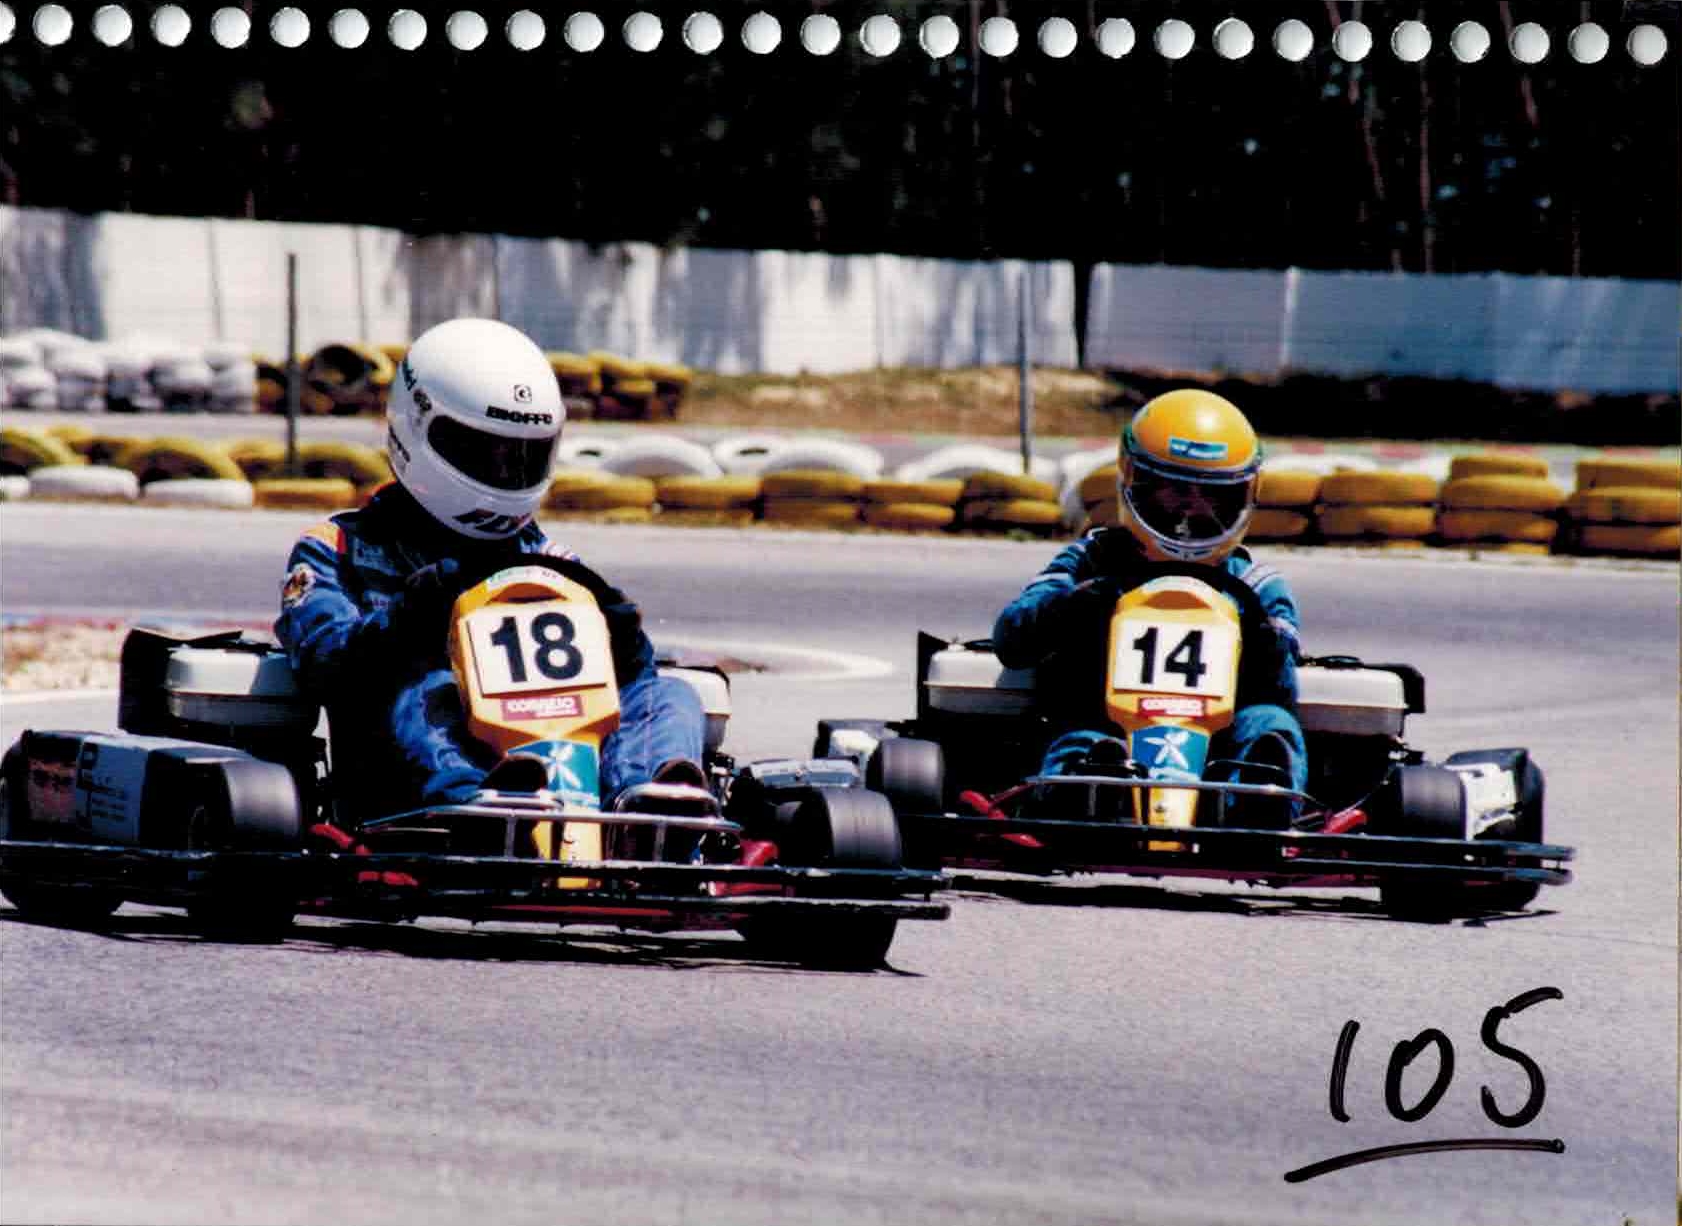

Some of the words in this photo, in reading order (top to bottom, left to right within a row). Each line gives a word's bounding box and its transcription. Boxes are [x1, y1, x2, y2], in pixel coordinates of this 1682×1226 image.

[490, 612, 583, 683] 18
[1133, 627, 1207, 687] 14
[1330, 986, 1563, 1128] 105
